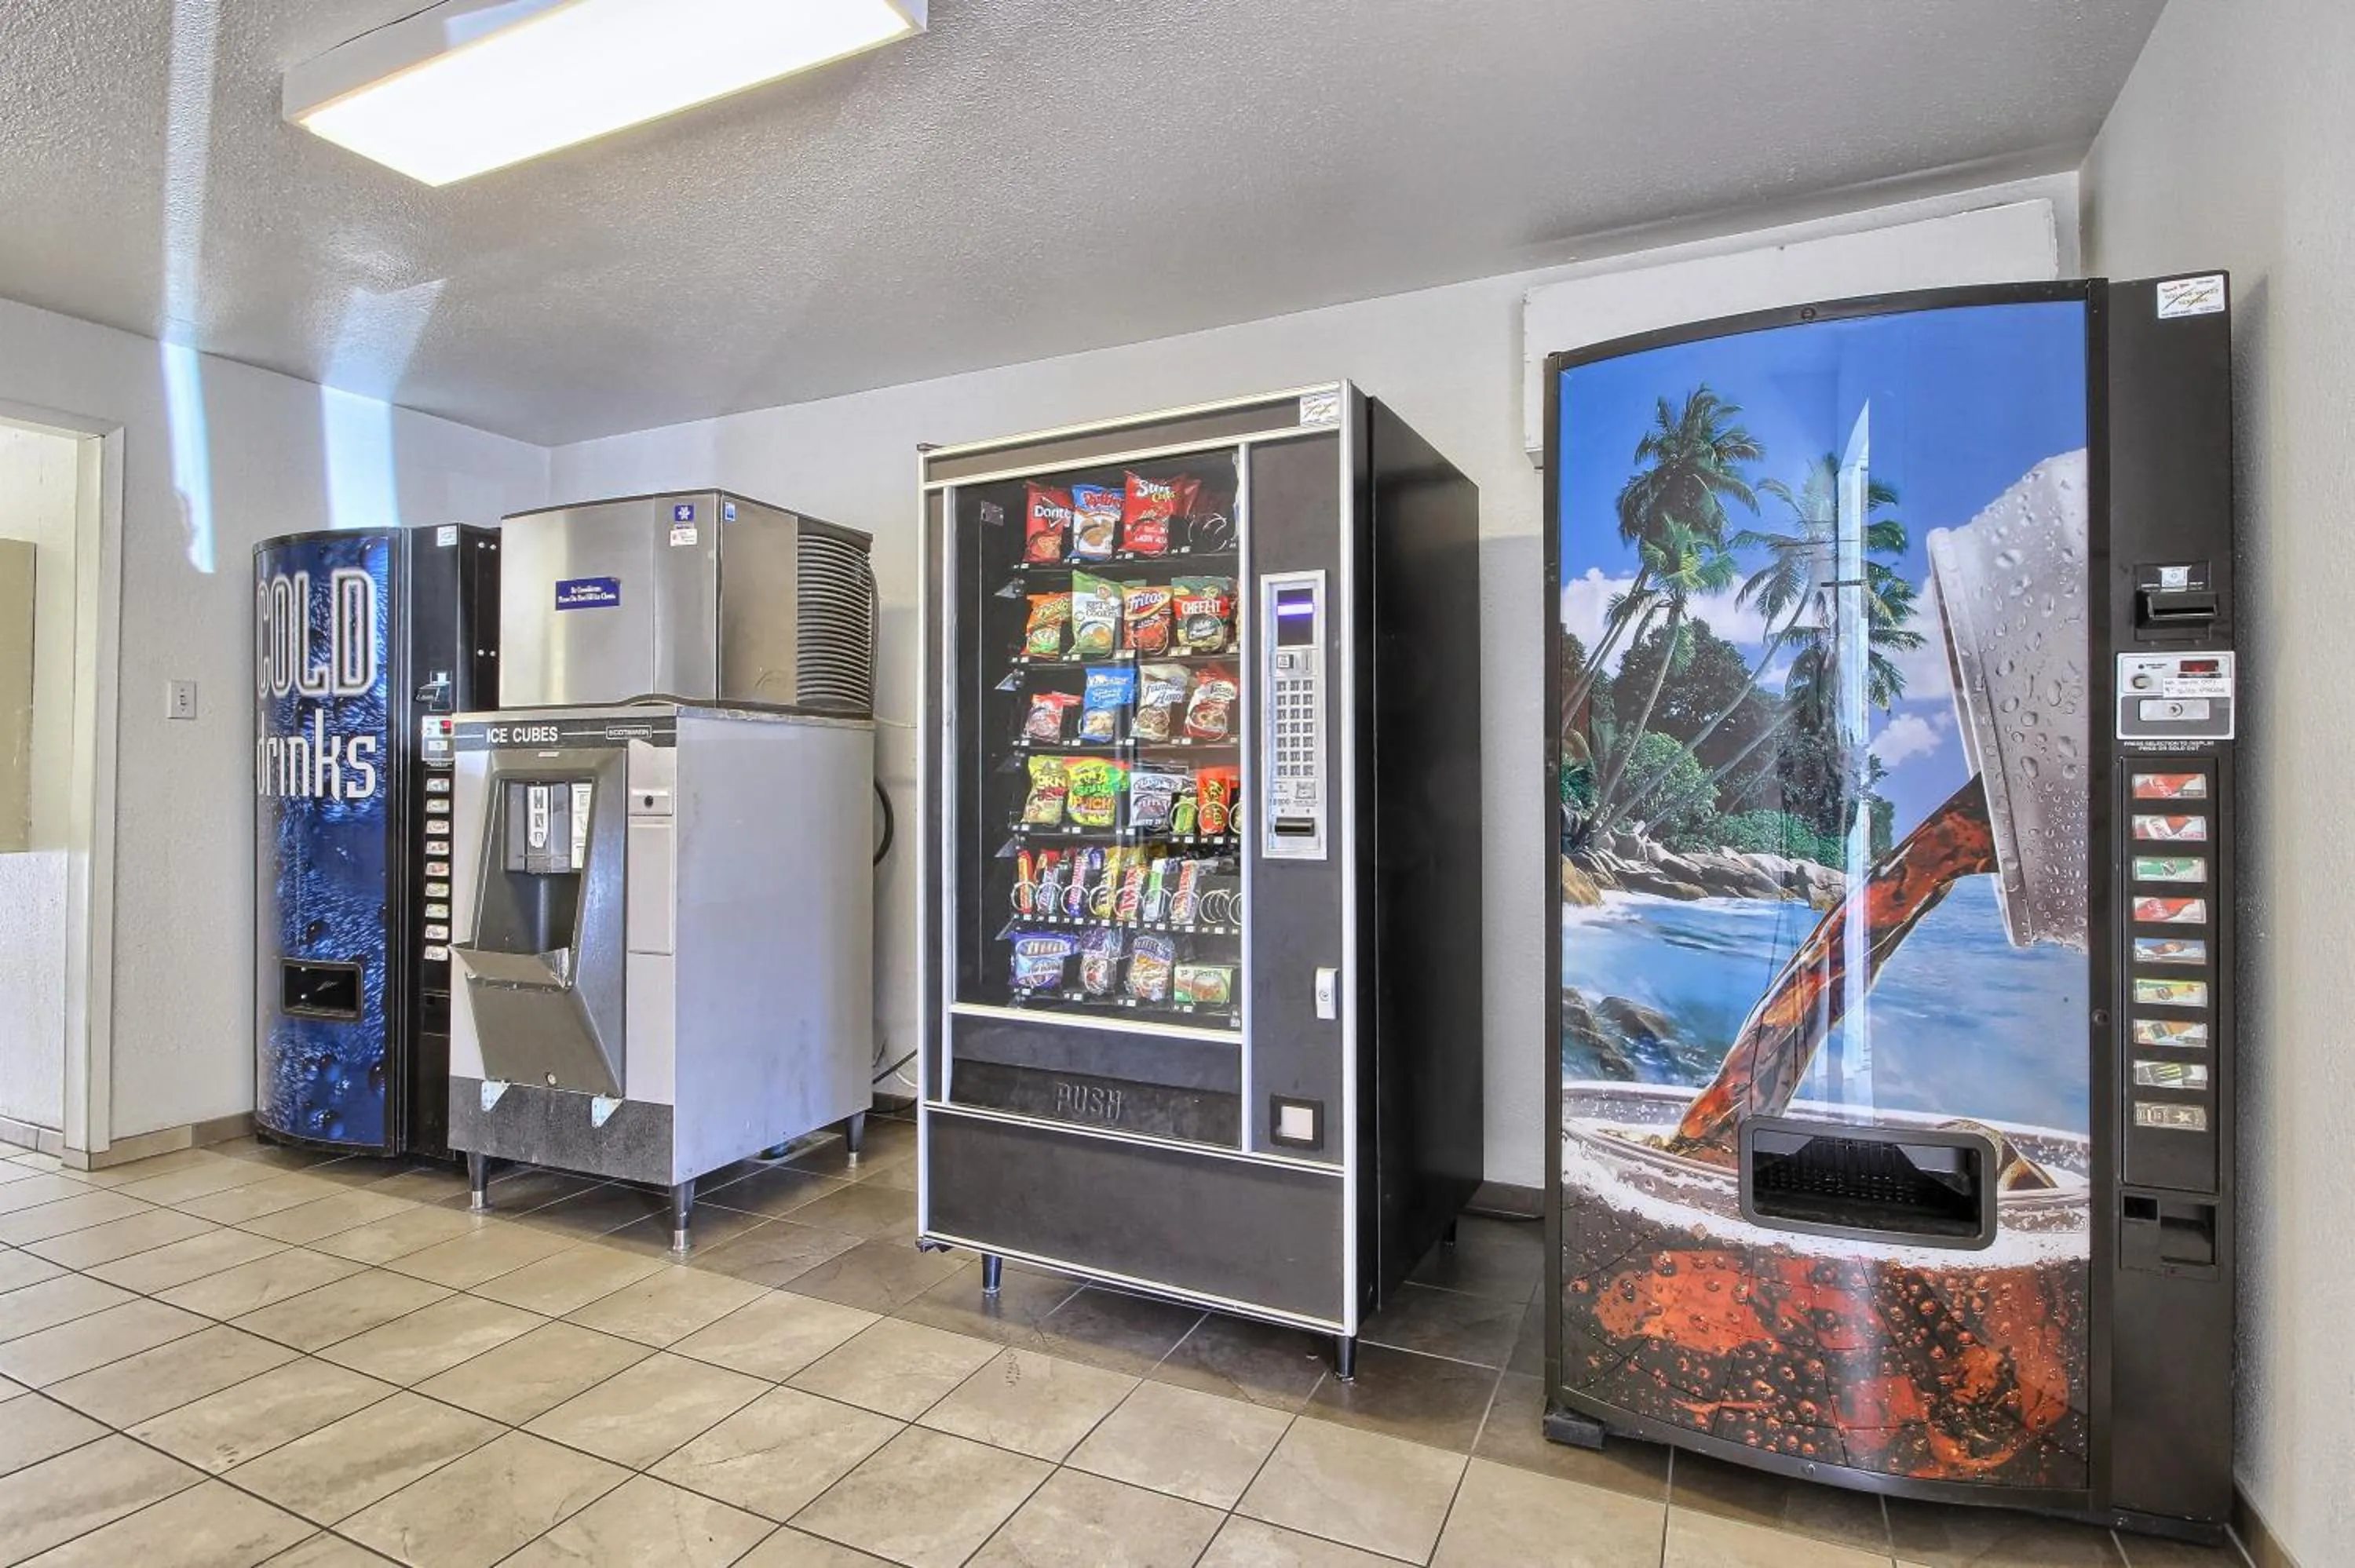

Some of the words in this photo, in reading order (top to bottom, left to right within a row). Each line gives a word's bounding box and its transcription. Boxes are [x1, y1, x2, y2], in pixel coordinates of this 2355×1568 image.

[257, 568, 377, 698] COLD
[257, 708, 377, 801] drinks
[487, 728, 508, 742] ICE
[513, 726, 558, 742] CUBES
[1057, 1082, 1122, 1120] PUSH
